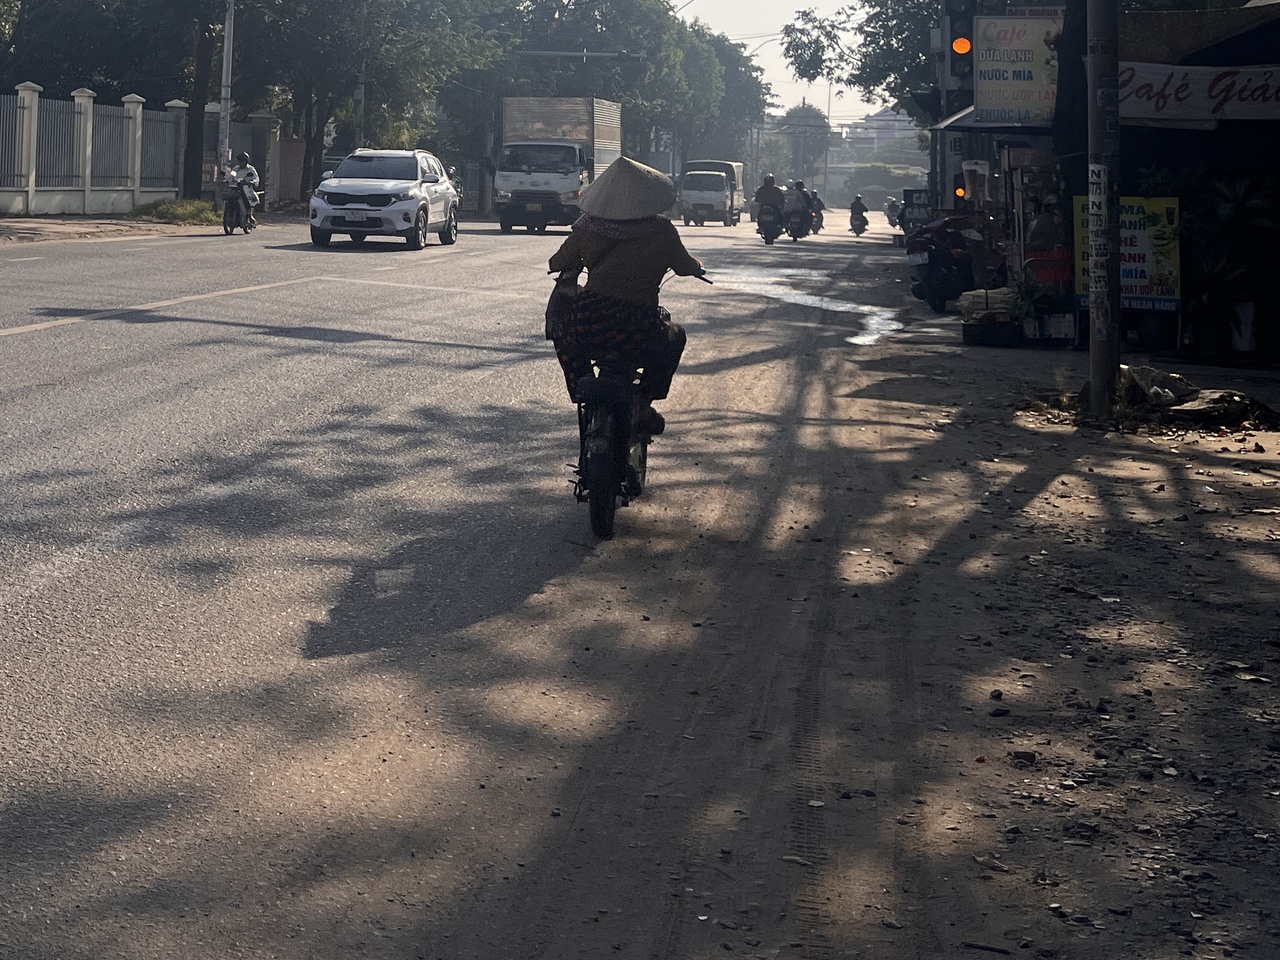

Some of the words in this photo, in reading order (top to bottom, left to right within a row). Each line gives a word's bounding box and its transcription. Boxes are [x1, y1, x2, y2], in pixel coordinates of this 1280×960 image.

[1004, 49, 1034, 65] LẠNH
[1207, 70, 1280, 114] Giả
[1120, 253, 1146, 265] ẠNH
